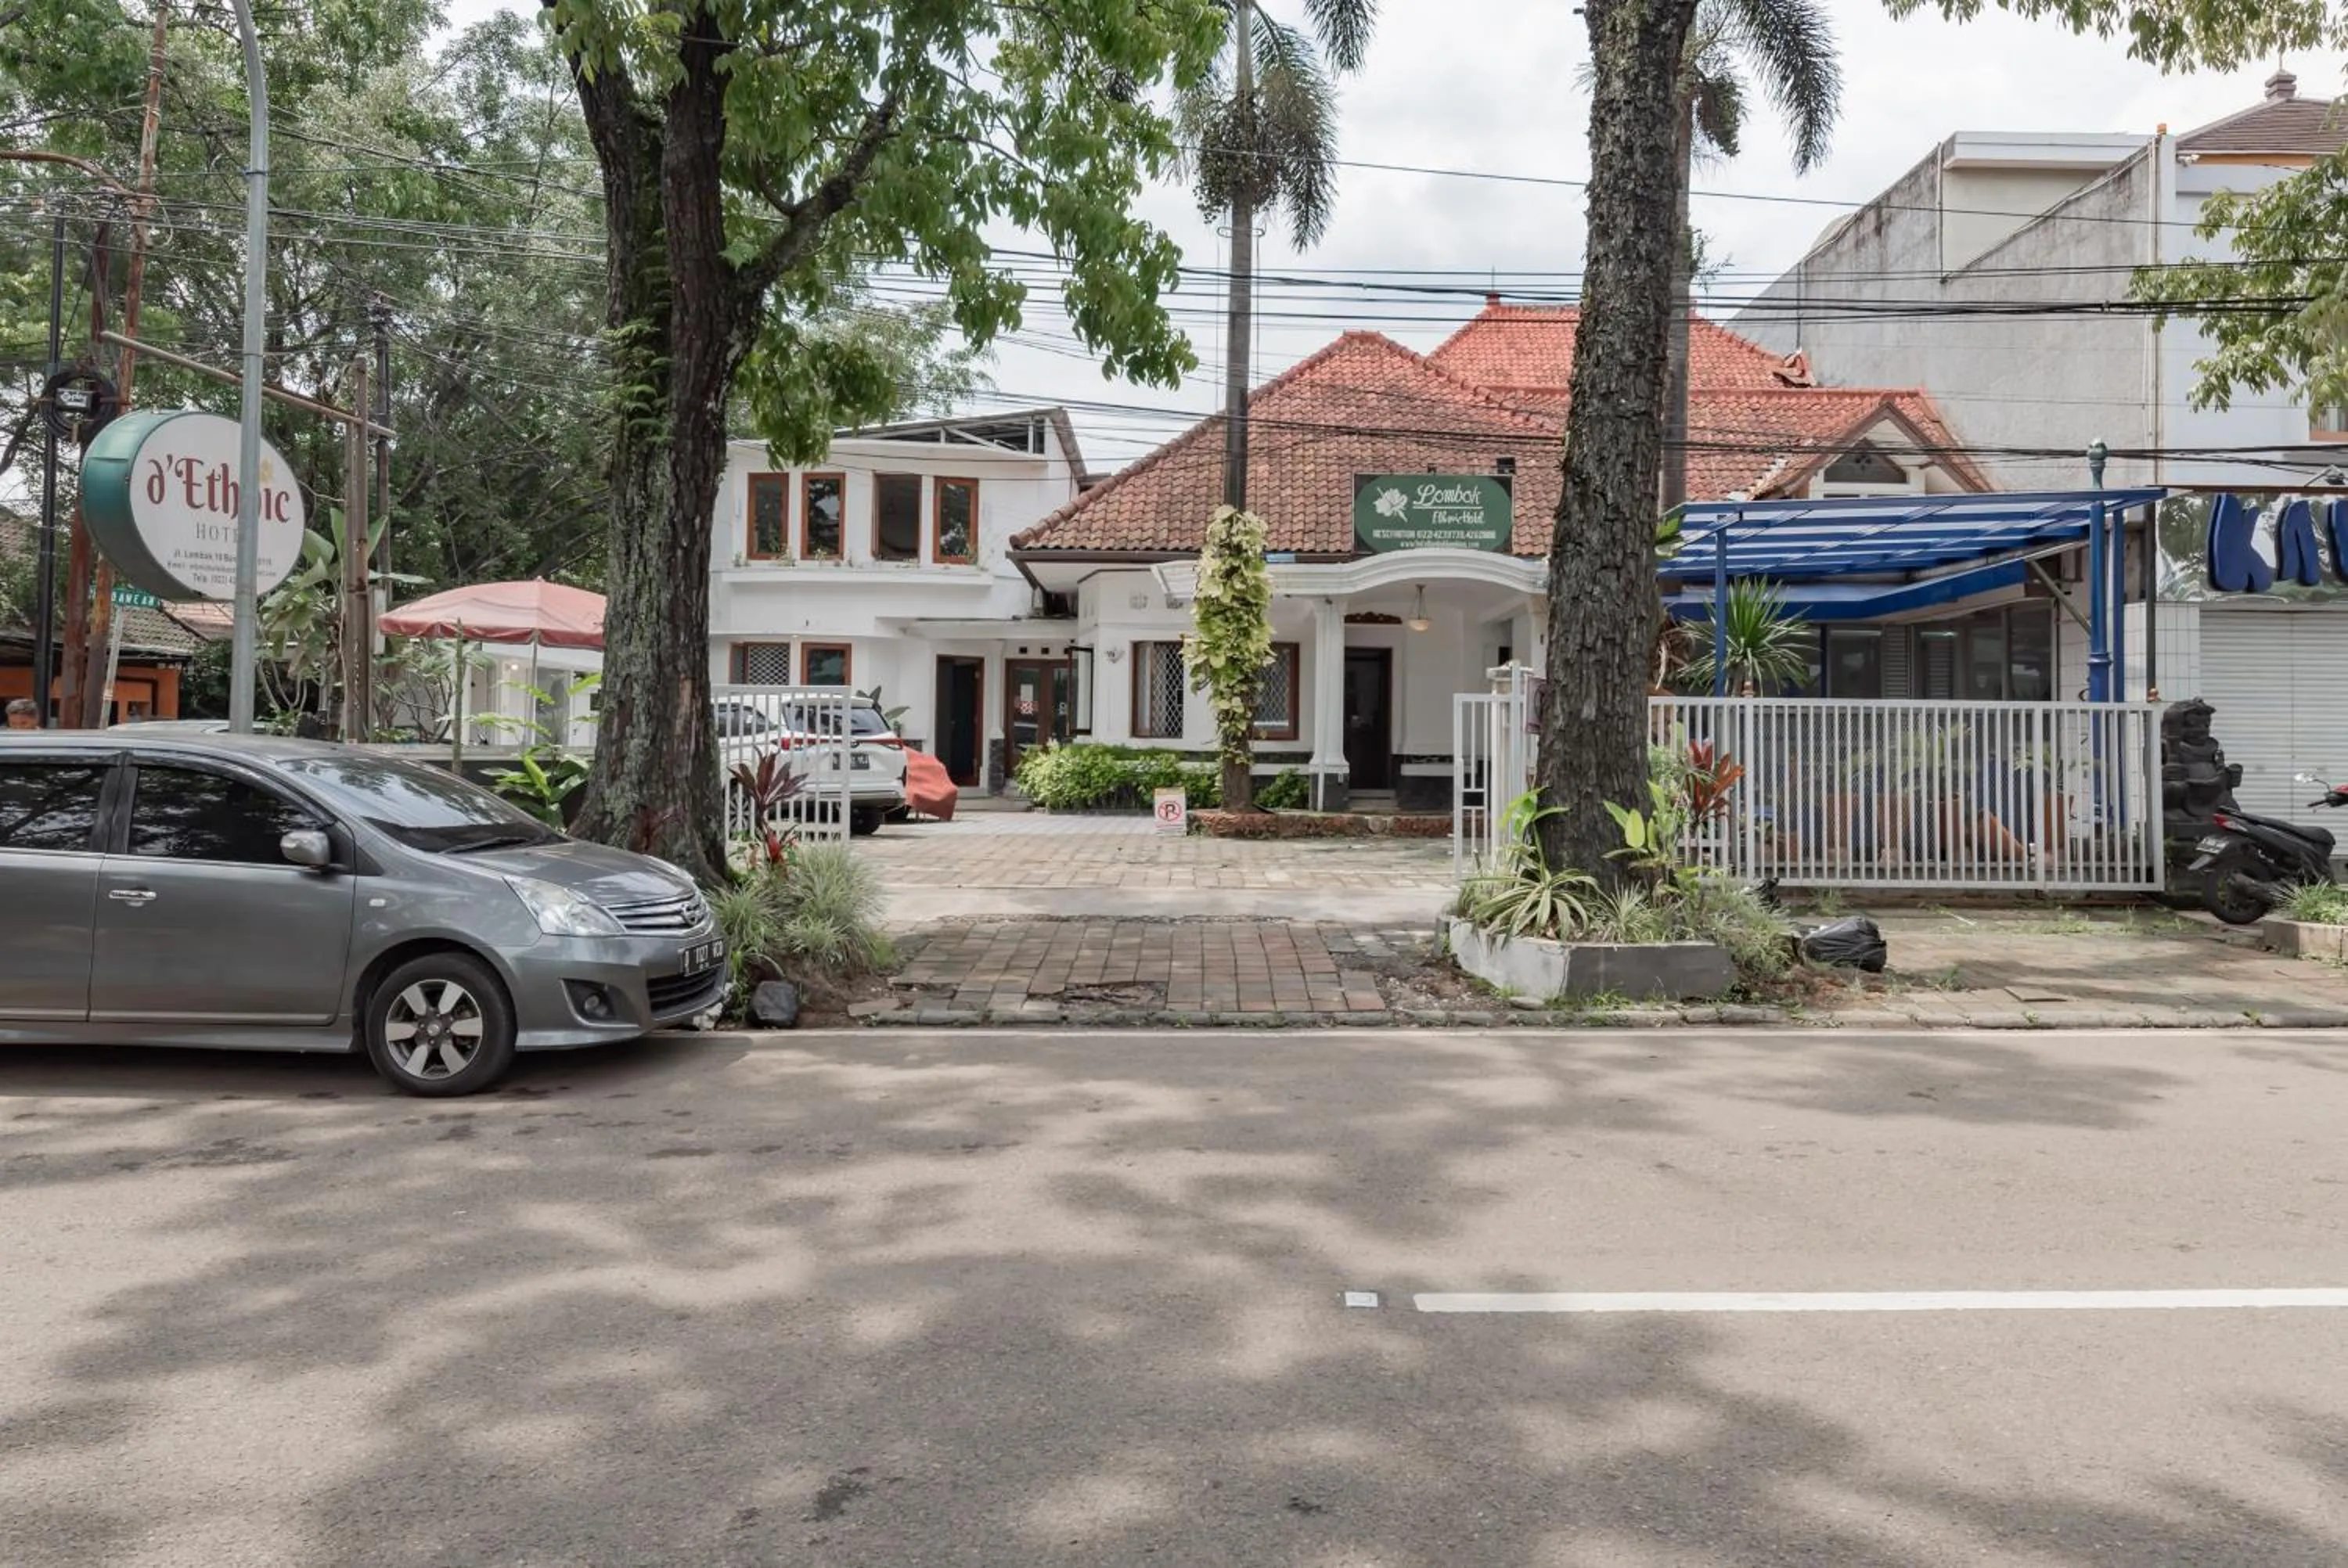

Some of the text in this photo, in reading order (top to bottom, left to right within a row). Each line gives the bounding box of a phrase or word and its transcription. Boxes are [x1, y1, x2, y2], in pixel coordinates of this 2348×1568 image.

[146, 454, 290, 523] d'Ethic
[1413, 484, 1481, 506] Lombok
[196, 523, 239, 543] HOT
